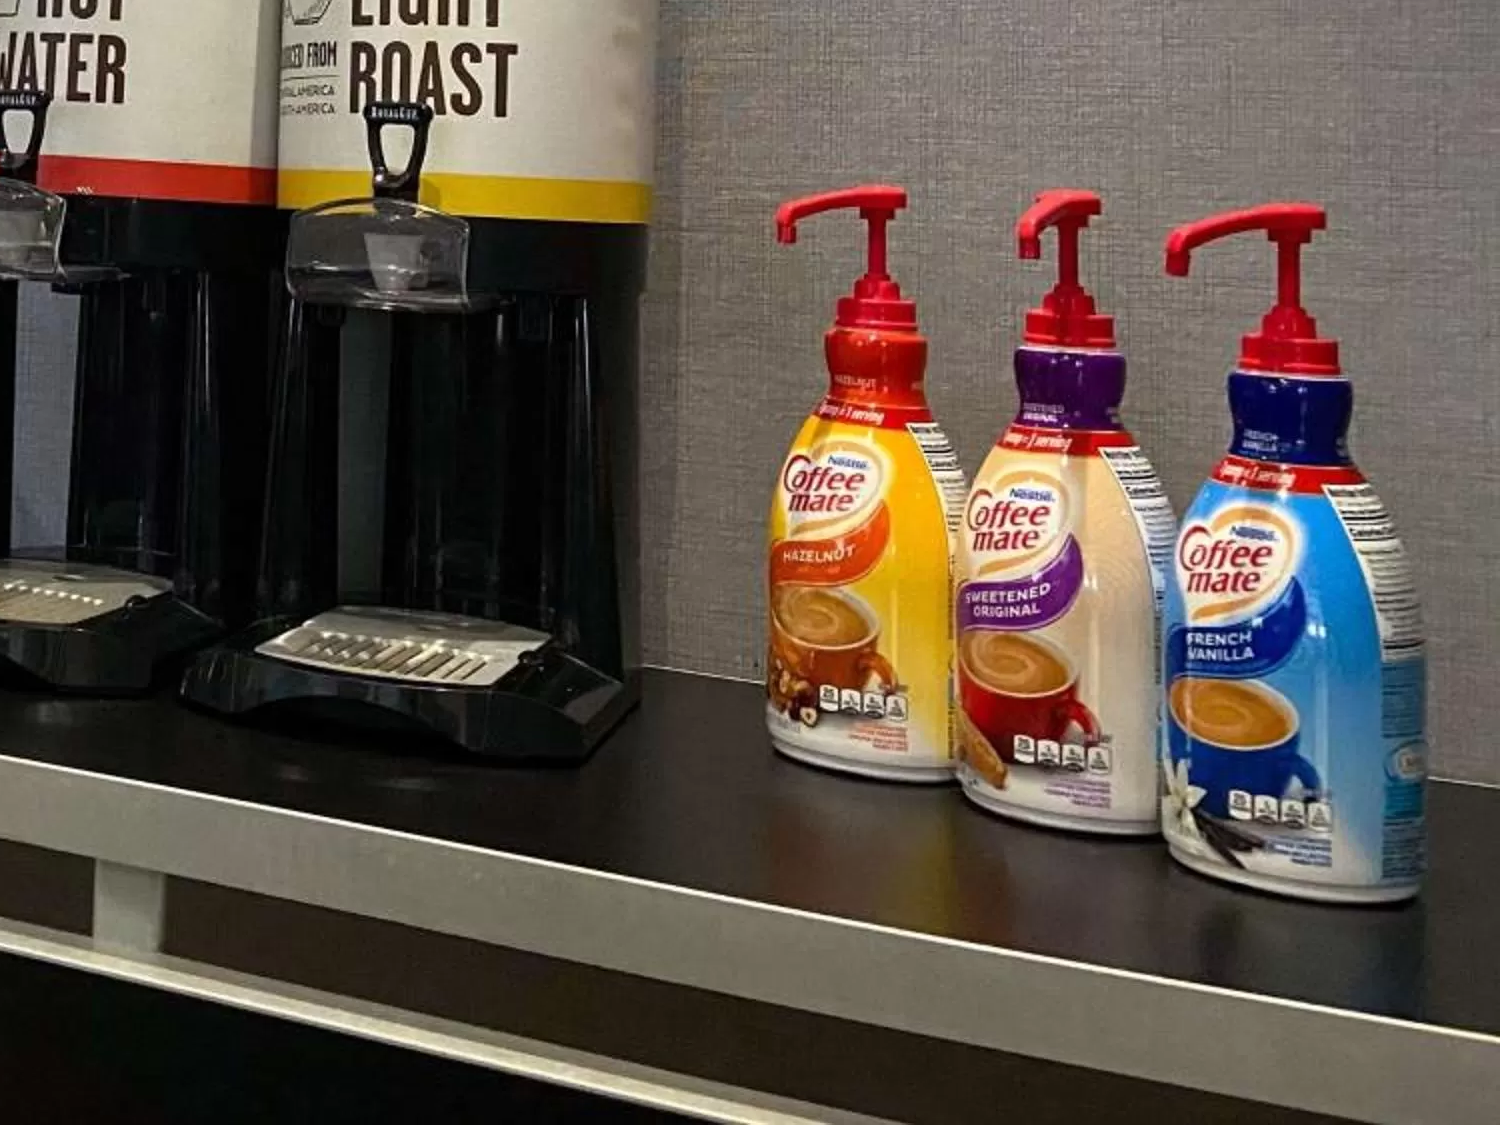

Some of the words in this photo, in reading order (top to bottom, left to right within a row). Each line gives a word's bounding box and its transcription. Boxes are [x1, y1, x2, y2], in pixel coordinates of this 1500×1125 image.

[308, 41, 337, 68] FROM
[349, 40, 519, 118] ROAST
[784, 454, 864, 494] Coffee
[788, 492, 853, 512] mate
[967, 488, 1050, 532] Coffee
[972, 528, 1040, 552] mate
[1180, 525, 1273, 572] Coffee
[783, 543, 856, 563] HAZELNUT
[965, 582, 1051, 604] SWEETENED
[1187, 571, 1260, 593] mate
[973, 603, 1041, 619] ORIGINAL
[1186, 630, 1252, 646] FRENCH
[1187, 646, 1254, 662] VANILLA
